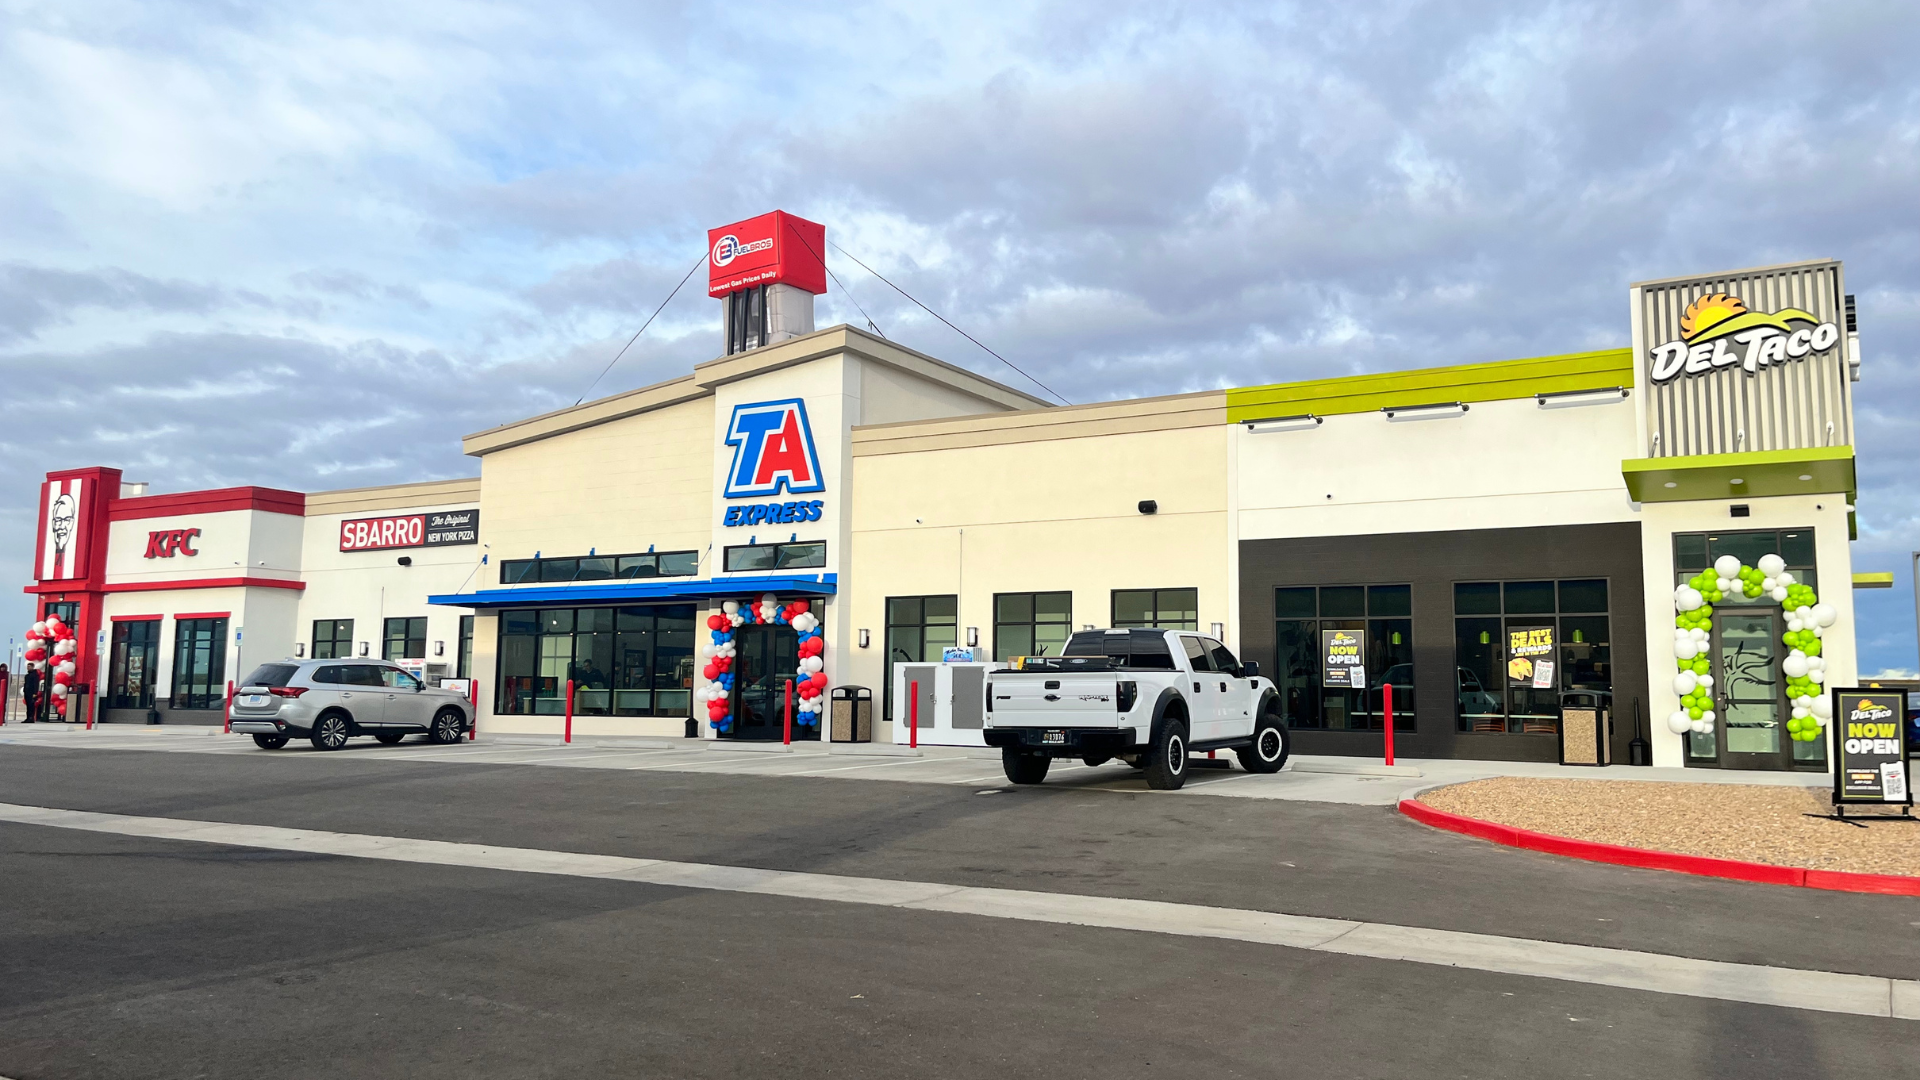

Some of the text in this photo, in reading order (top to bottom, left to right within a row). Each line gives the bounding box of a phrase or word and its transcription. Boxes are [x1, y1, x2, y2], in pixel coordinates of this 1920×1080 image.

[710, 282, 730, 292] Lowest
[743, 275, 760, 284] Prices
[761, 271, 776, 279] Daily
[1650, 322, 1839, 383] DEL TACO
[727, 401, 820, 494] TA
[431, 513, 471, 527] The Original
[723, 500, 824, 527] EXPRESS
[342, 517, 422, 548] SBARRO
[428, 530, 475, 543] NEW YORK PIZZA
[143, 528, 202, 559] KFC
[1510, 629, 1552, 639] THE BEST
[1511, 635, 1552, 649] DEALS
[1330, 646, 1358, 655] NOW
[1327, 655, 1360, 664] OPEN
[1850, 709, 1892, 720] DEL TACO
[1848, 723, 1896, 738] NOW
[1845, 739, 1900, 754] OPEN
